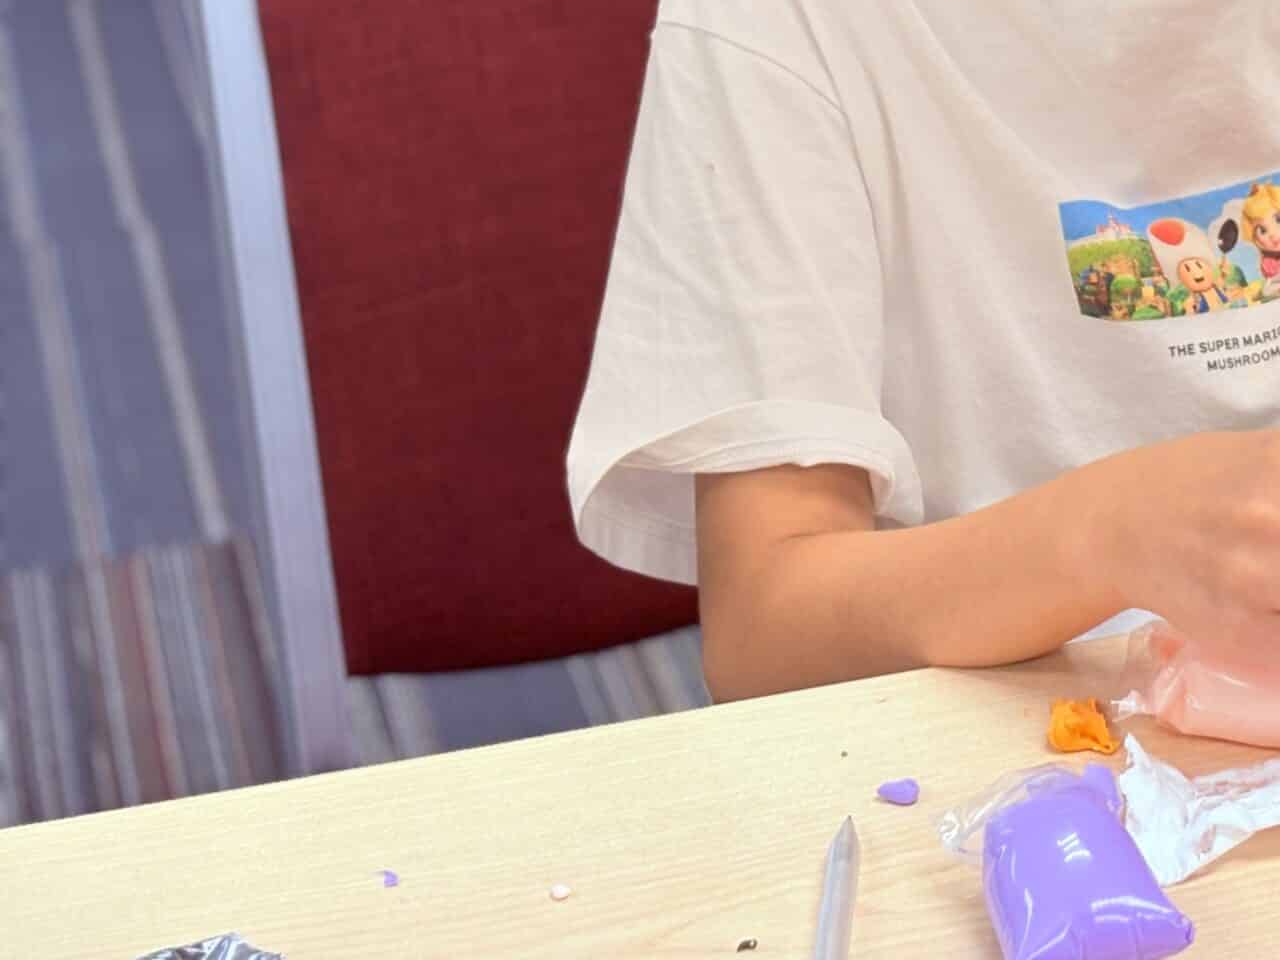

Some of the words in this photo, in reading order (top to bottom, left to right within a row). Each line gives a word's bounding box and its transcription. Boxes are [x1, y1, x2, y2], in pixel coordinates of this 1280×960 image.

[1168, 343, 1196, 357] THE
[1198, 337, 1240, 354] SUPER
[1207, 346, 1280, 372] MUSHROOM
